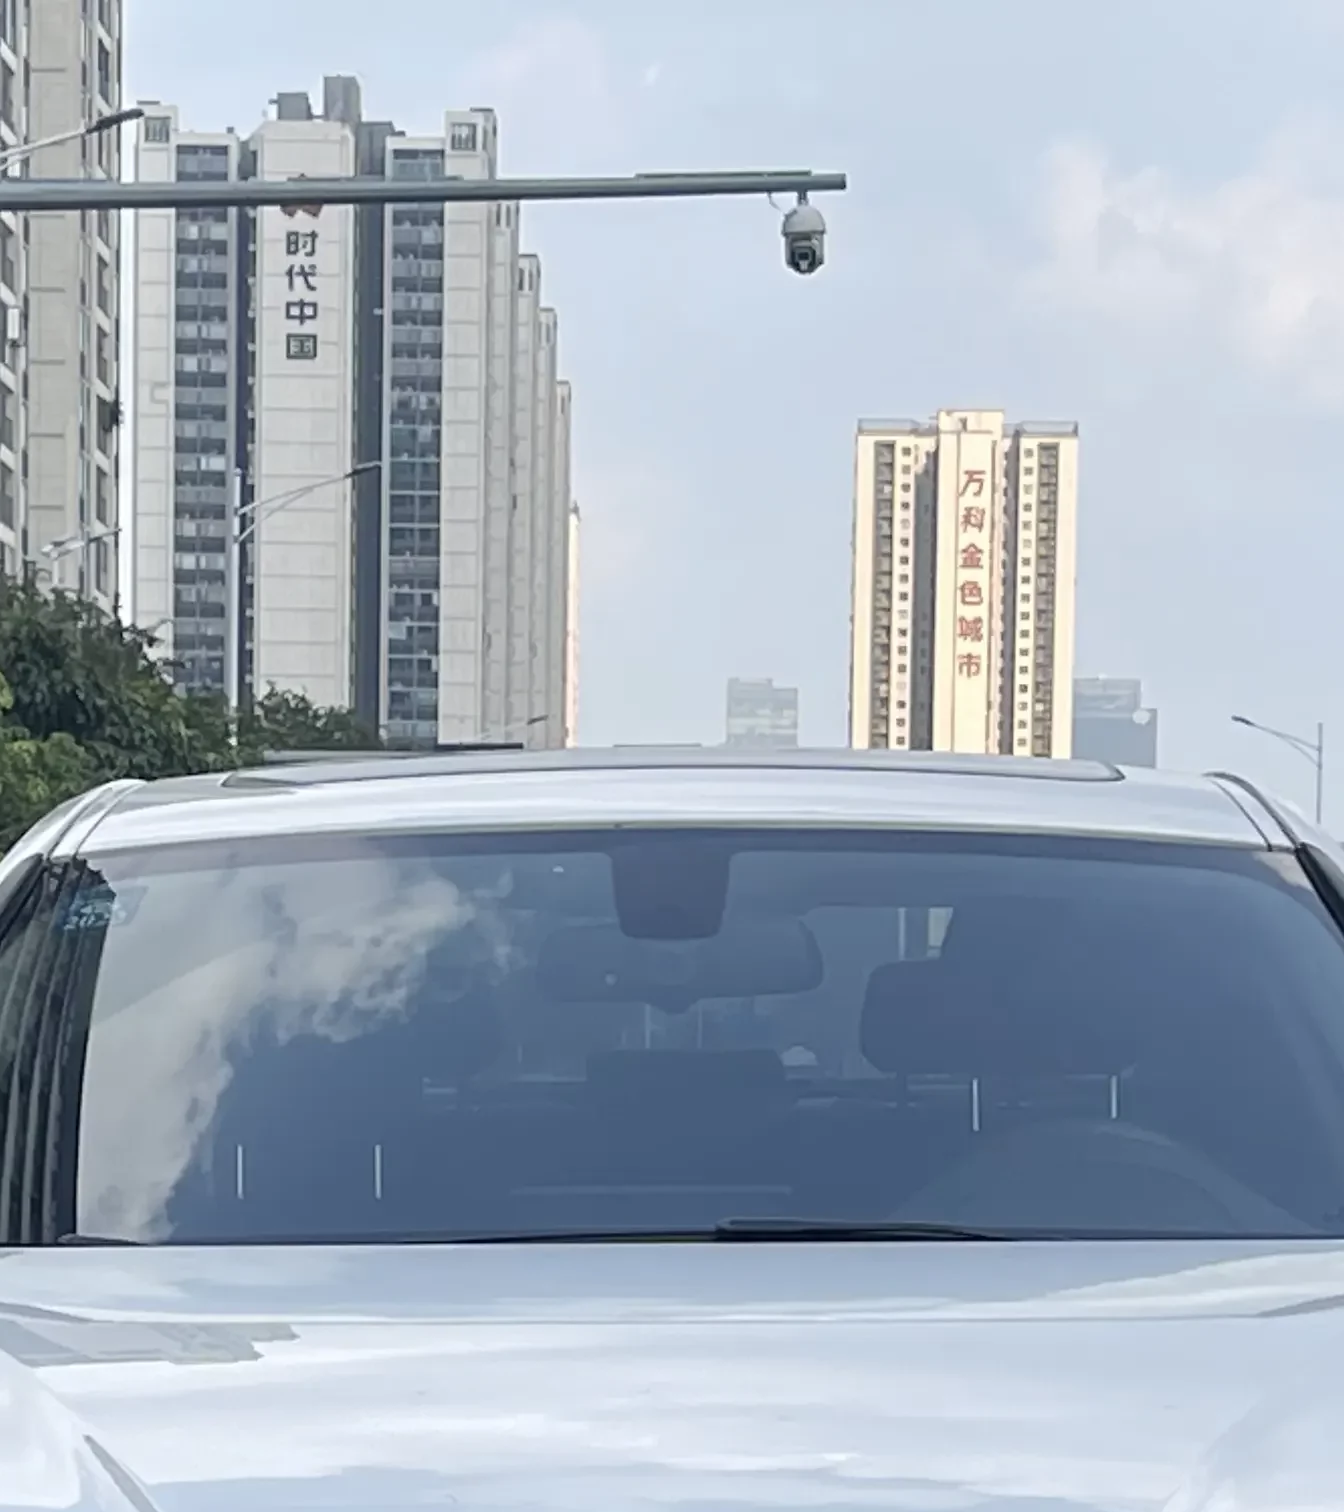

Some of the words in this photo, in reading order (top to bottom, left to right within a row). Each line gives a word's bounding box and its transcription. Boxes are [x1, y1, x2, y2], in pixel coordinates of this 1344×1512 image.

[285, 230, 318, 360] 时代中国
[957, 469, 986, 679] 万科金色城市
